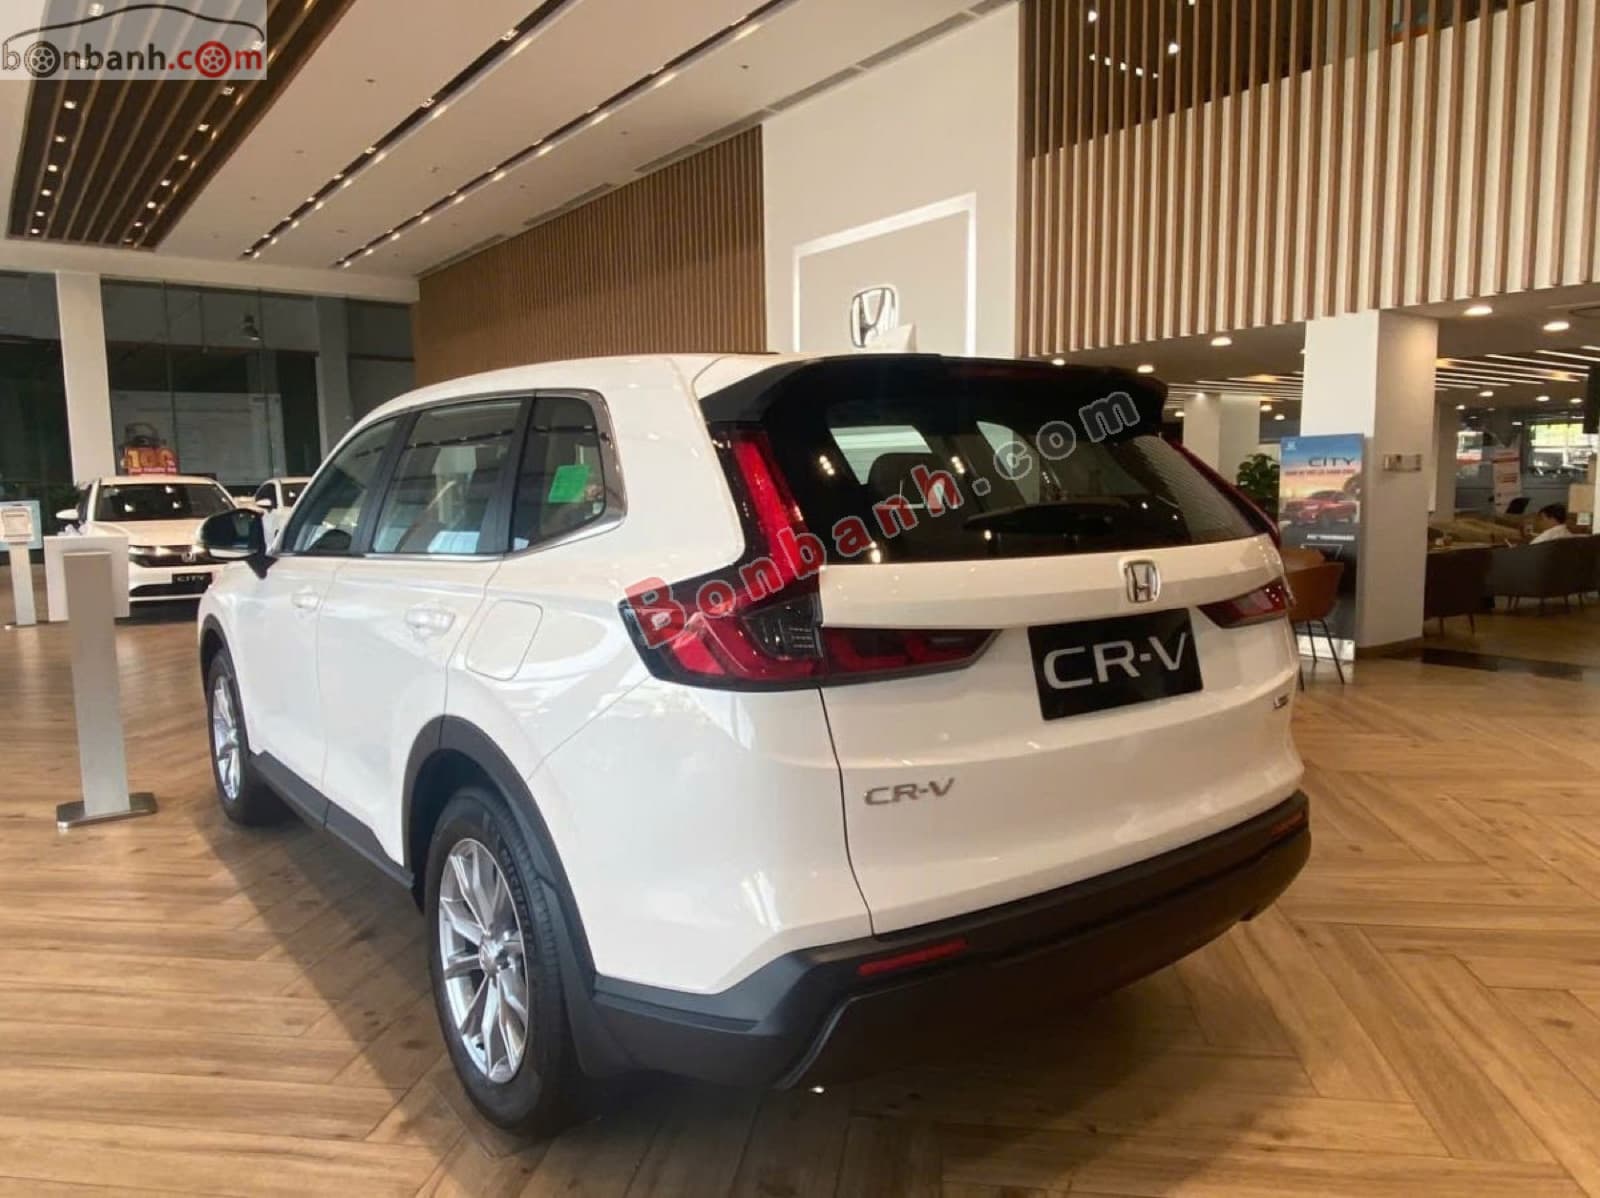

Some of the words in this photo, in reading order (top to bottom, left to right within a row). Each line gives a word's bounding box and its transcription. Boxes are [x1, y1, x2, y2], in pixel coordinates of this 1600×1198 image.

[1308, 456, 1356, 467] CITY
[1043, 631, 1187, 690] CR-V
[863, 777, 955, 806] CR-V
